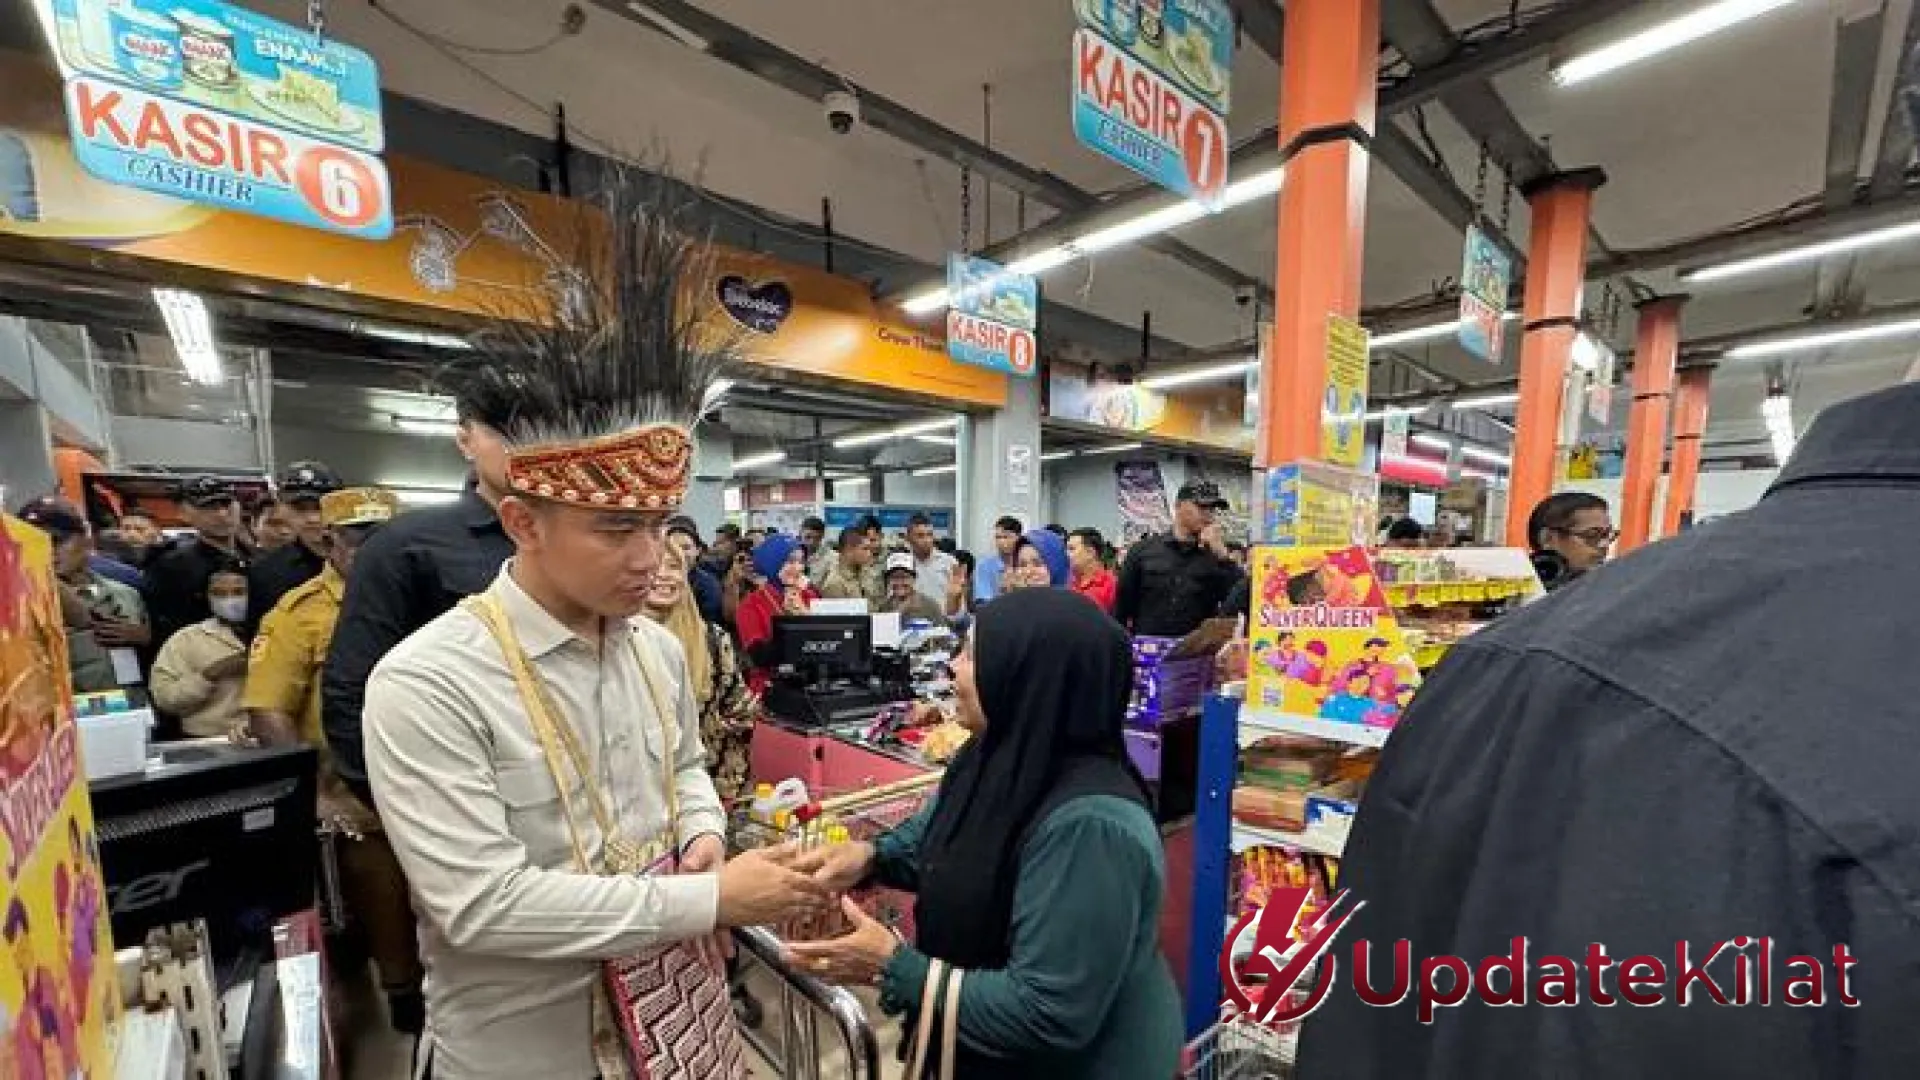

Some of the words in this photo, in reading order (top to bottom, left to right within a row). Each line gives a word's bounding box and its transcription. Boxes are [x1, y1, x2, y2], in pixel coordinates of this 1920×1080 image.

[76, 82, 291, 184] KASIR
[319, 157, 361, 216] 6
[1081, 34, 1183, 153] KASIR
[1197, 120, 1214, 187] 7
[127, 157, 253, 203] CASHIER
[951, 315, 1007, 351] KASIR
